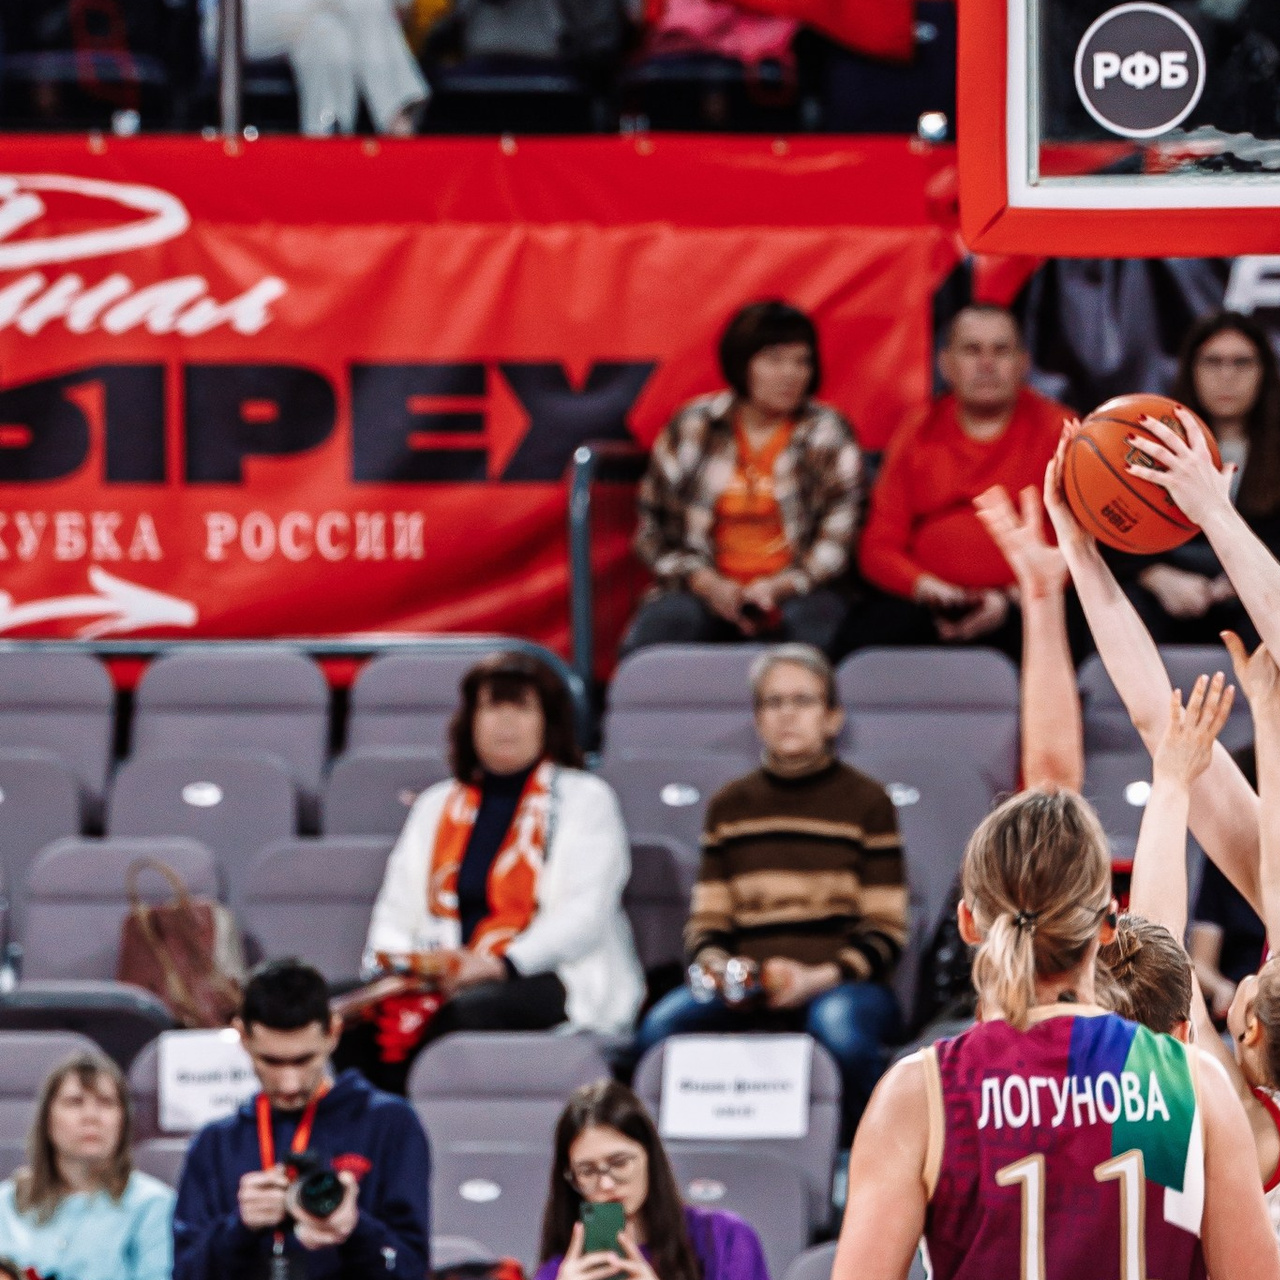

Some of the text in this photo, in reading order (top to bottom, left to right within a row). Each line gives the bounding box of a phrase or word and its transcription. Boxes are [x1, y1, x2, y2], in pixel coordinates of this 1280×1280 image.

[1092, 51, 1189, 90] РФБ
[205, 511, 425, 561] РОССИИ
[978, 1071, 1170, 1129] ЛОГУНОВА
